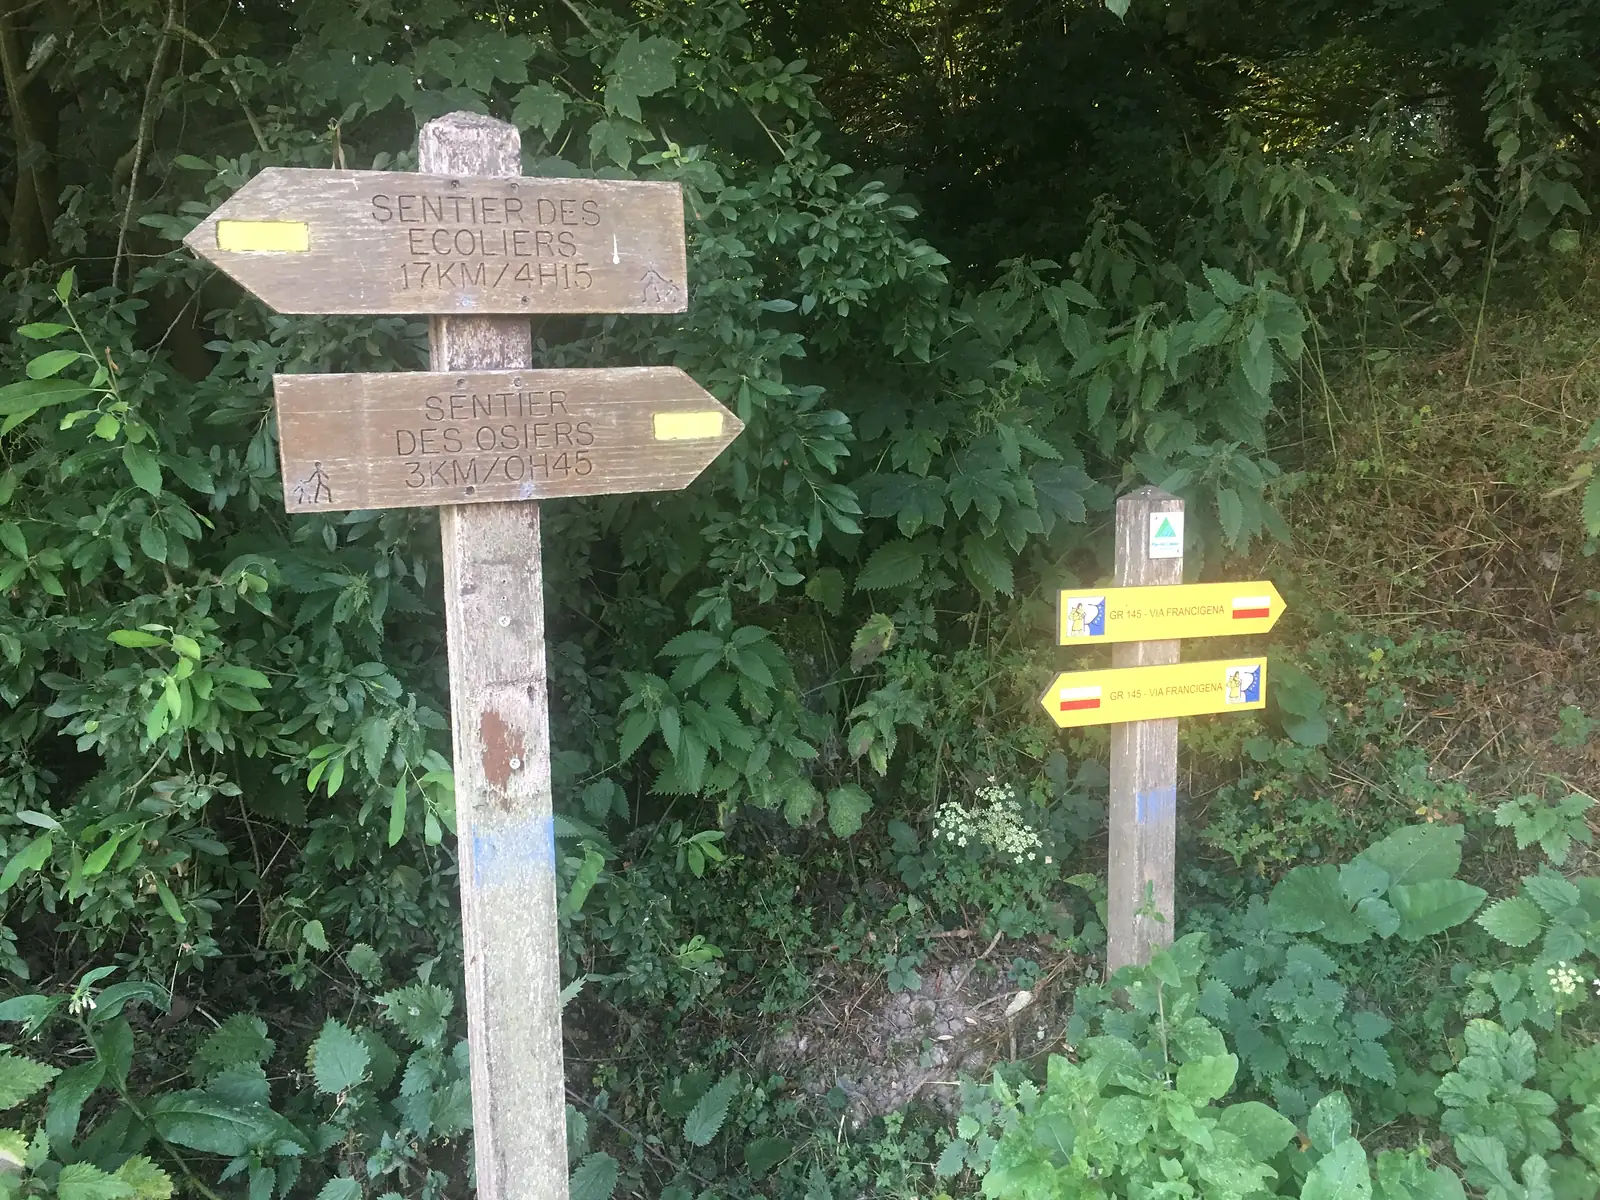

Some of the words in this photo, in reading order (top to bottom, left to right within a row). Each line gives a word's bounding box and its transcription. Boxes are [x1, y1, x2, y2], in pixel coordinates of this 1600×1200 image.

[371, 194, 524, 225] SENTIER
[537, 198, 601, 227] DES
[409, 228, 577, 258] ECOLIERS
[400, 262, 593, 290] 17KM/4H15
[424, 390, 569, 421] SENTIER
[396, 427, 463, 457] DES
[476, 421, 595, 451] OSIERS
[1109, 610, 1124, 620] GR
[1126, 608, 1142, 619] 145
[1149, 608, 1164, 618] VIA
[1166, 605, 1225, 617] FRANCIGENA
[1109, 691, 1124, 701] GR
[1126, 689, 1142, 700] 145
[1149, 687, 1164, 698] VIA
[1165, 683, 1223, 696] FRANCIGENA
